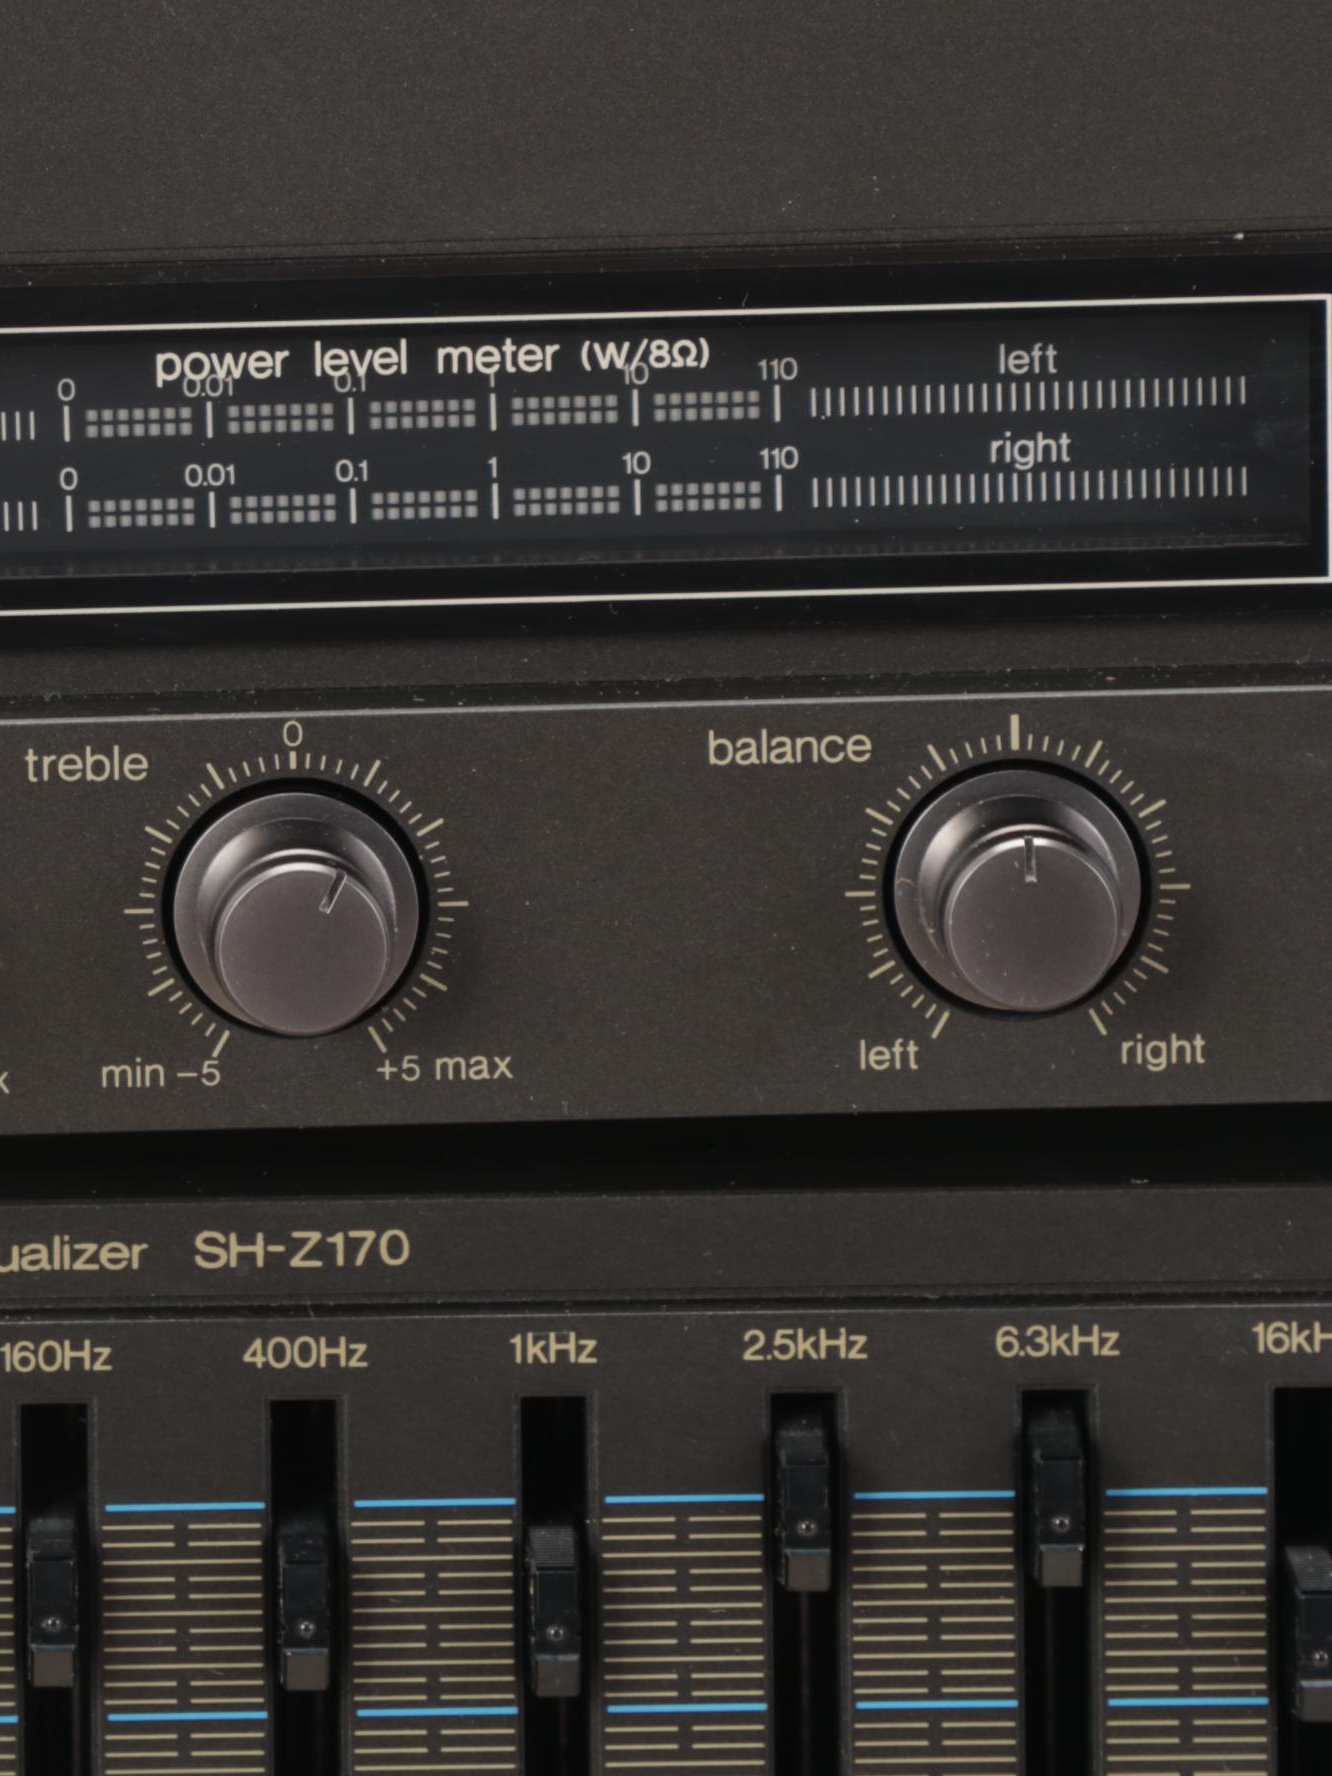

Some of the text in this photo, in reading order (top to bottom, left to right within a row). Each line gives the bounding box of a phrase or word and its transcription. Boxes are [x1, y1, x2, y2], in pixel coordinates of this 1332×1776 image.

[154, 346, 292, 390] power
[312, 336, 409, 379] level
[434, 336, 563, 376] meter
[999, 342, 1058, 375] left
[57, 378, 76, 402] 0
[758, 357, 798, 381] 110
[59, 466, 78, 491] 0
[184, 462, 235, 488] 0.01
[335, 458, 368, 483] 0.1
[622, 450, 652, 475] 10
[759, 445, 799, 470] 110
[990, 431, 1072, 471] right
[279, 715, 307, 747] 0
[708, 728, 872, 766] balance
[24, 744, 149, 783] treble
[376, 1055, 514, 1082] +5 max
[859, 1038, 919, 1071] left
[1121, 1033, 1206, 1072] right
[101, 1056, 165, 1089] min
[194, 1228, 410, 1270] SH-Z170
[0, 1338, 113, 1373] 160Hz
[242, 1335, 369, 1369] 400Hz
[509, 1331, 598, 1364] 1kHz
[742, 1327, 868, 1361] 2.5kHz
[995, 1324, 1121, 1358] 6.3kHz
